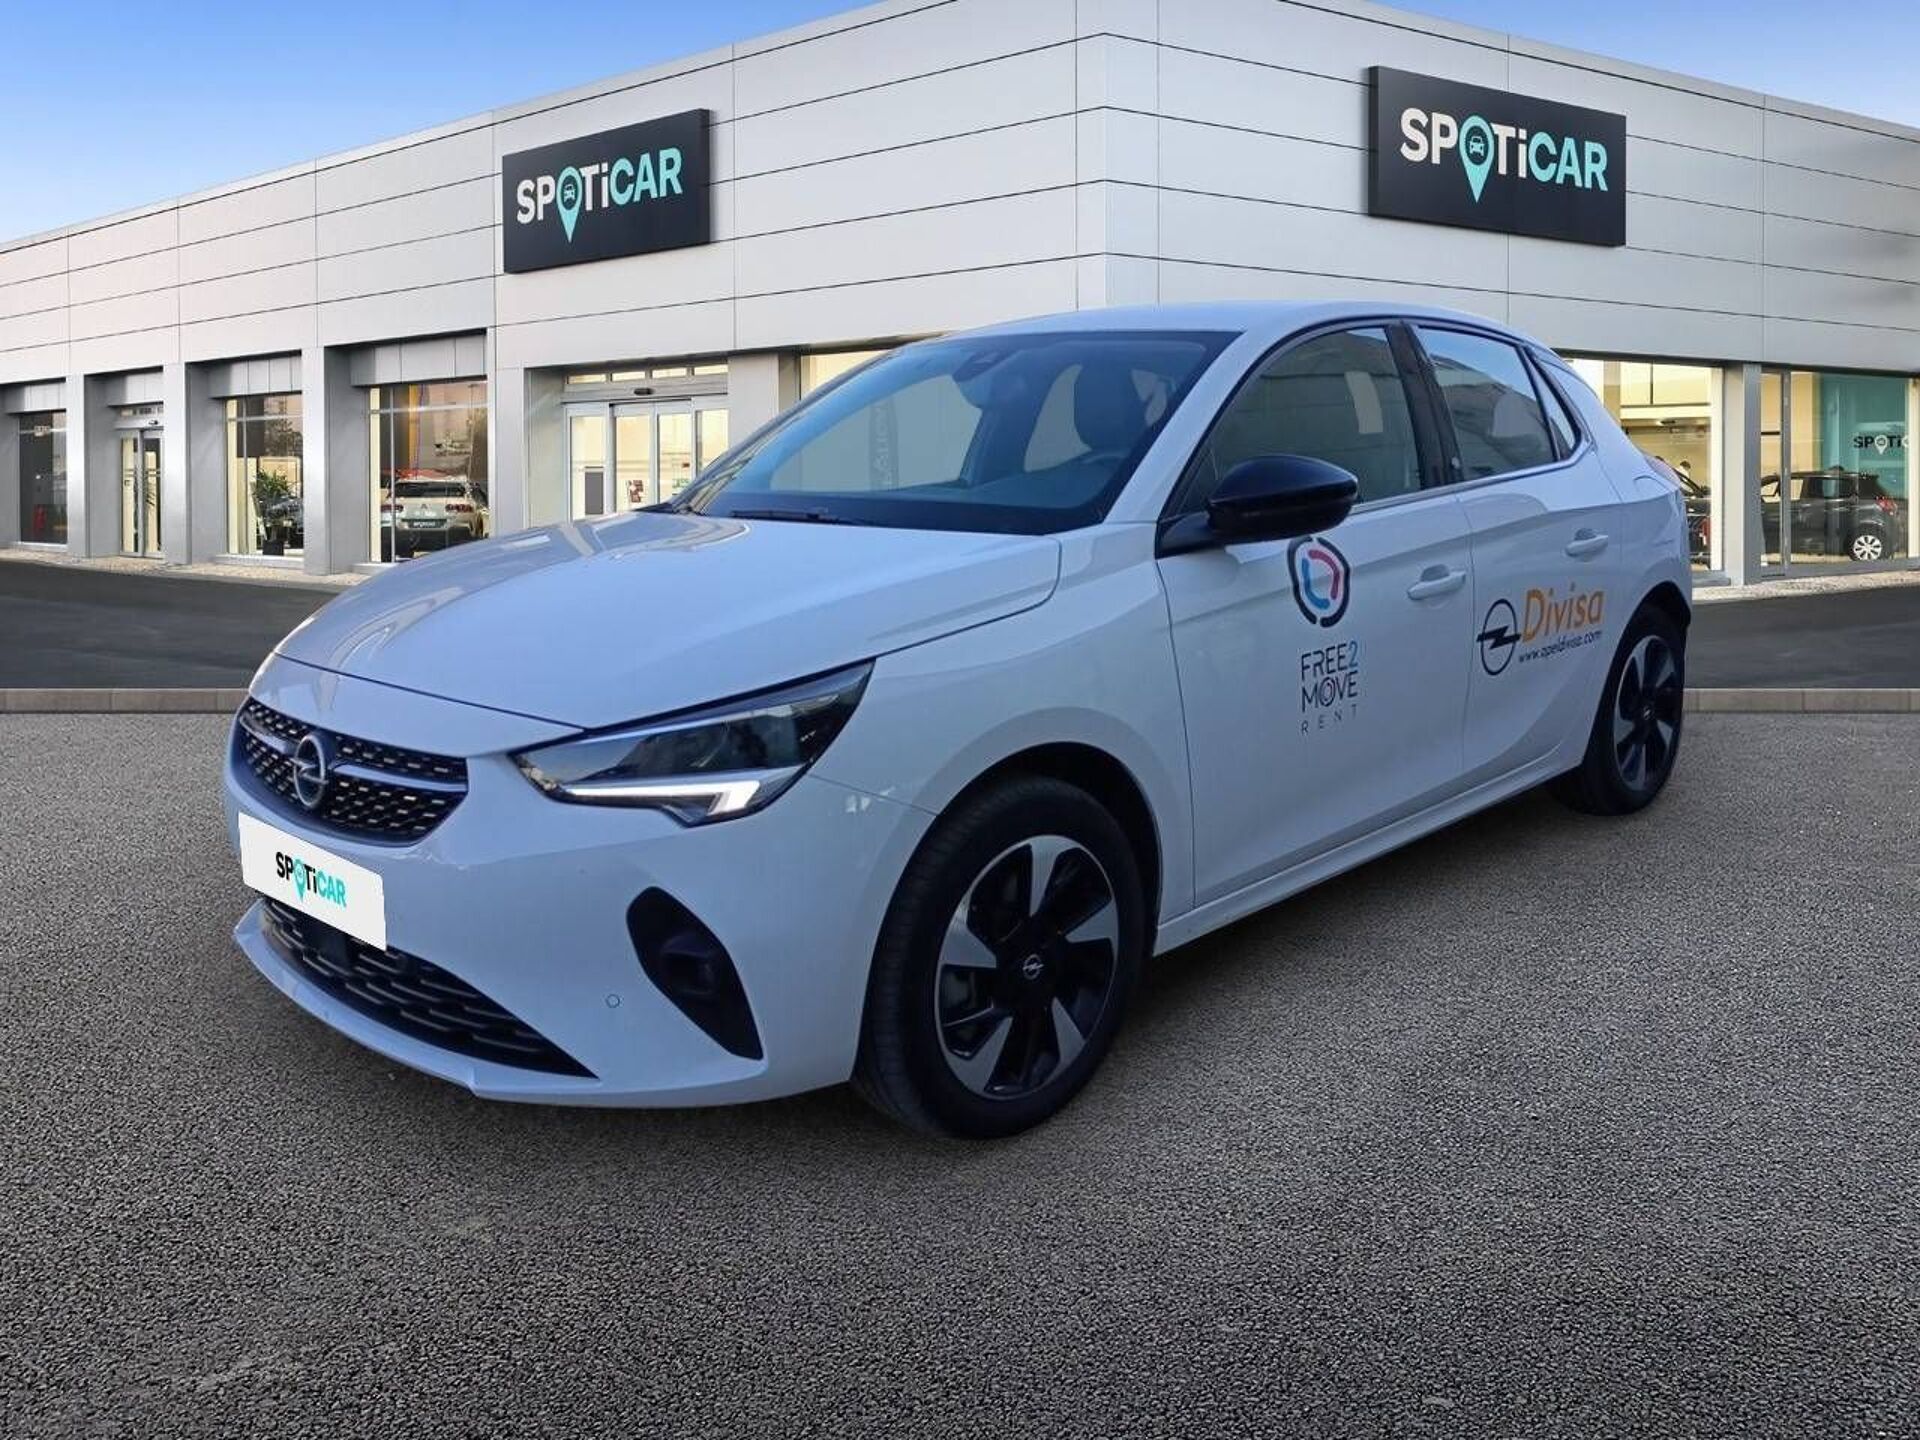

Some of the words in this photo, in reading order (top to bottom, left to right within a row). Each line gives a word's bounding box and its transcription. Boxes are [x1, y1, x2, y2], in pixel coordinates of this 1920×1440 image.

[1400, 108, 1608, 202] SPOTiCAR
[516, 147, 683, 243] SPOTiCAR
[1523, 581, 1604, 643] Divisa
[1301, 640, 1358, 683] FREE2
[1301, 670, 1358, 713] MOVE
[1301, 704, 1358, 735] RENT
[275, 851, 347, 908] SPOTiCAR
